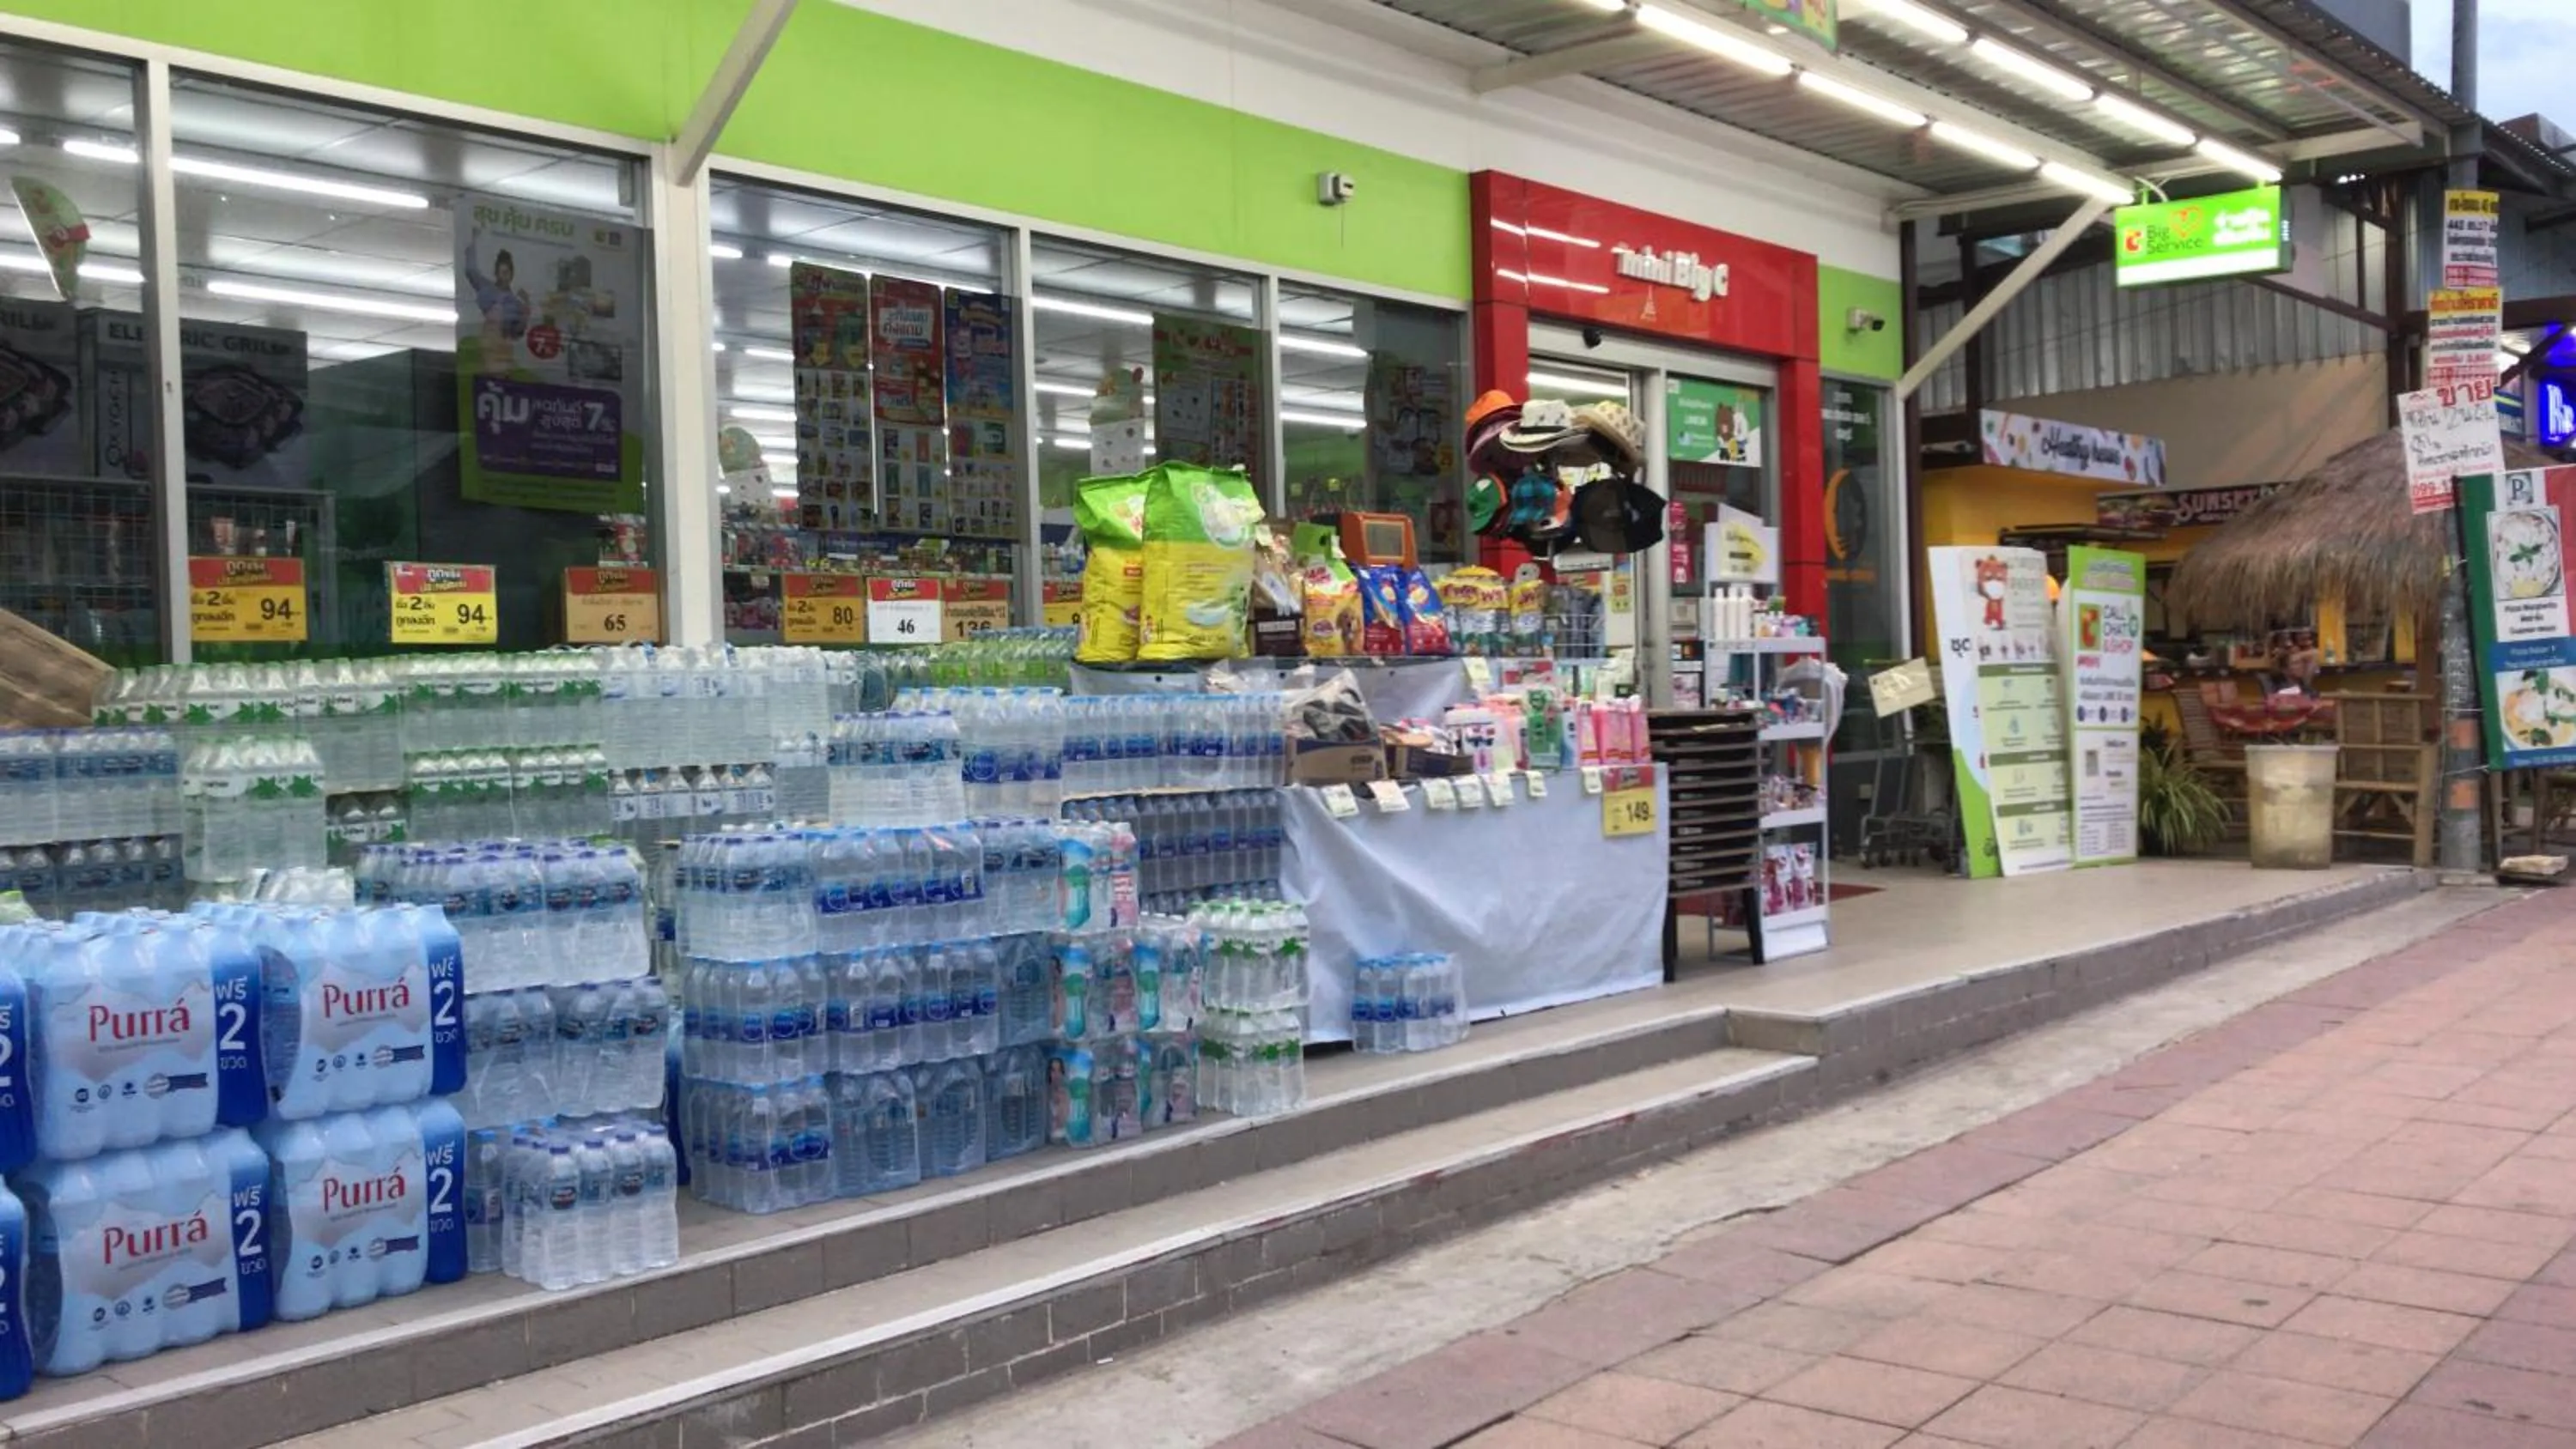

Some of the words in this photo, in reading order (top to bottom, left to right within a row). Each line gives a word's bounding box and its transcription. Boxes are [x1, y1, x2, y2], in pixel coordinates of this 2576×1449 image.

[2147, 224, 2170, 240] Big
[2147, 237, 2204, 254] Service
[477, 380, 529, 435] คุ้ม
[2437, 379, 2494, 408] ขาย
[206, 590, 221, 606] 2
[410, 596, 422, 611] 2
[604, 614, 626, 632] 65
[897, 618, 915, 634] 46
[216, 975, 248, 1001] ฟรี
[322, 976, 410, 1019] Purrá
[434, 979, 456, 1027] 2
[88, 997, 191, 1043] Purrá
[219, 1002, 247, 1051] 2
[220, 1055, 247, 1070] ขวด
[427, 1140, 455, 1167] ฟรี
[234, 1184, 262, 1208] ฟรี
[322, 1166, 405, 1215] Purrá
[429, 1167, 453, 1215] 2
[103, 1209, 208, 1265] Purrá
[235, 1209, 263, 1258] 2
